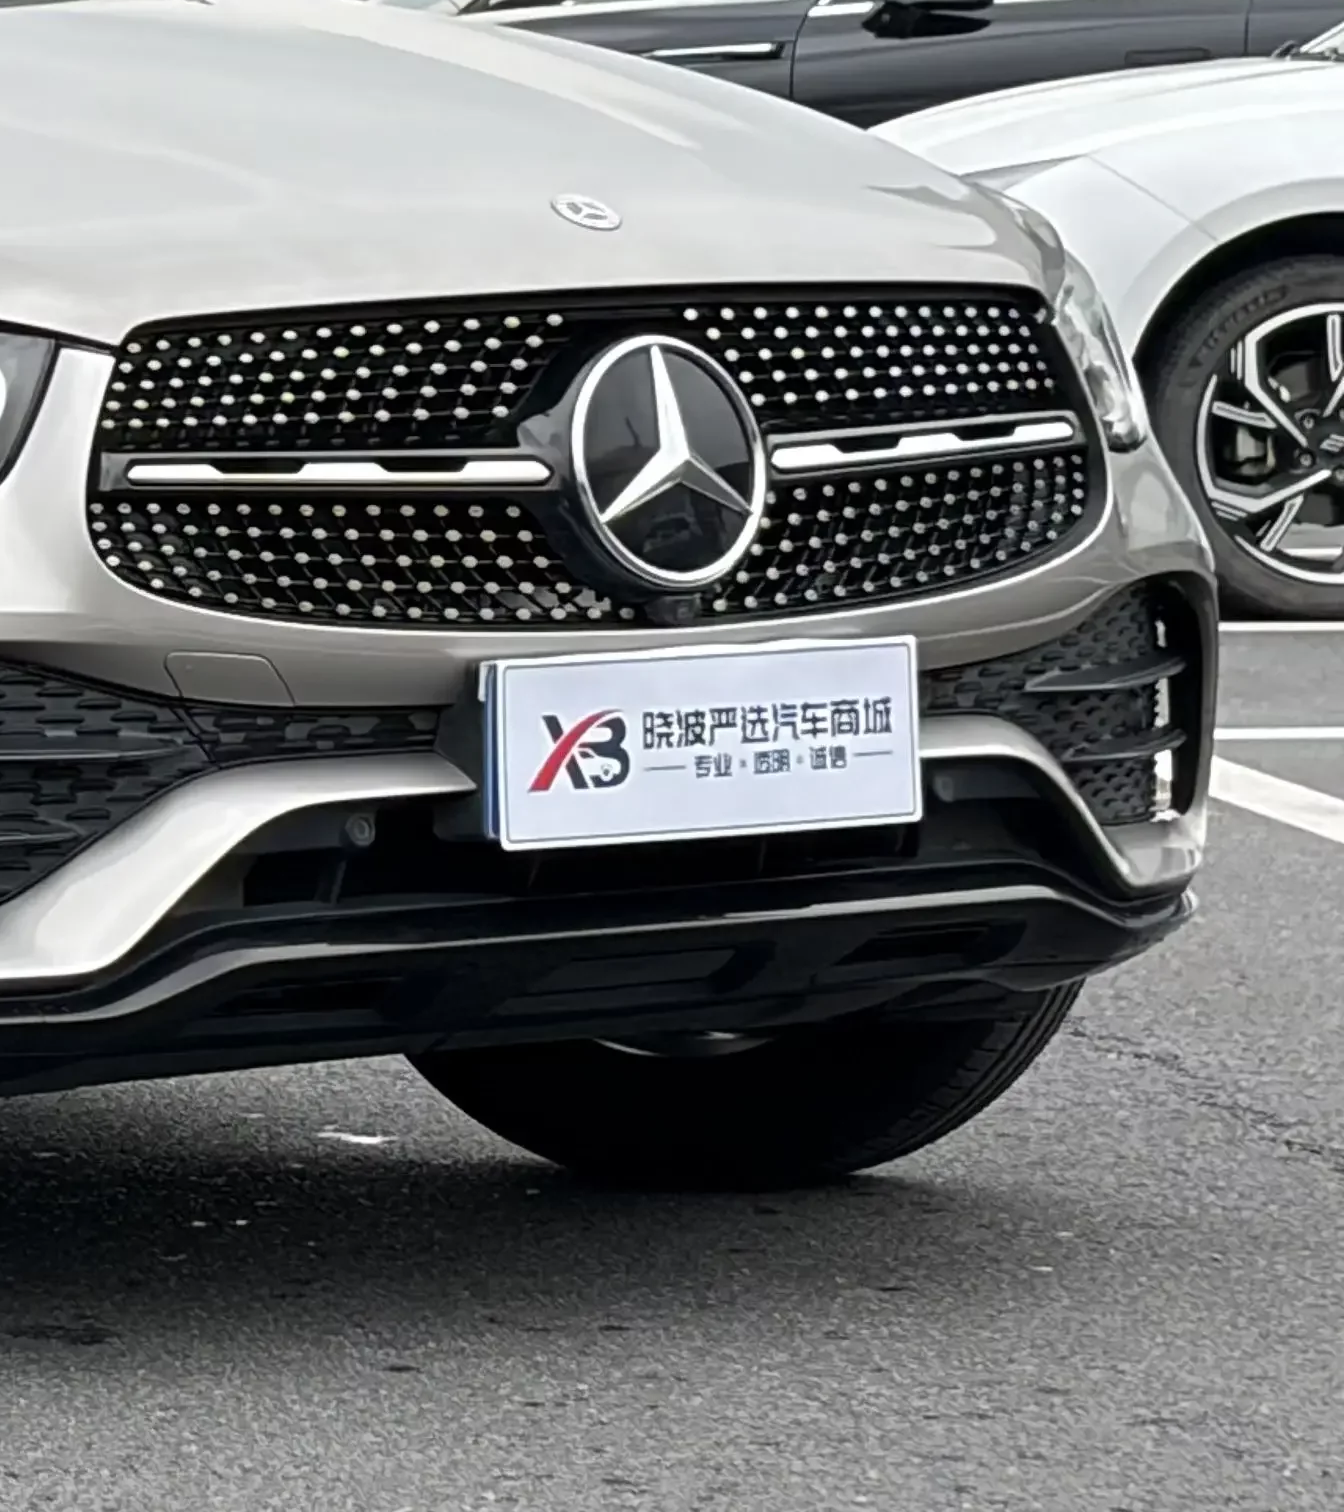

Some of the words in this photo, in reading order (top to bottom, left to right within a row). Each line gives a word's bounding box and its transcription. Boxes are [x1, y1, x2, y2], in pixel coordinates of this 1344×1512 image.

[642, 696, 892, 749] 晓波严选汽车商城
